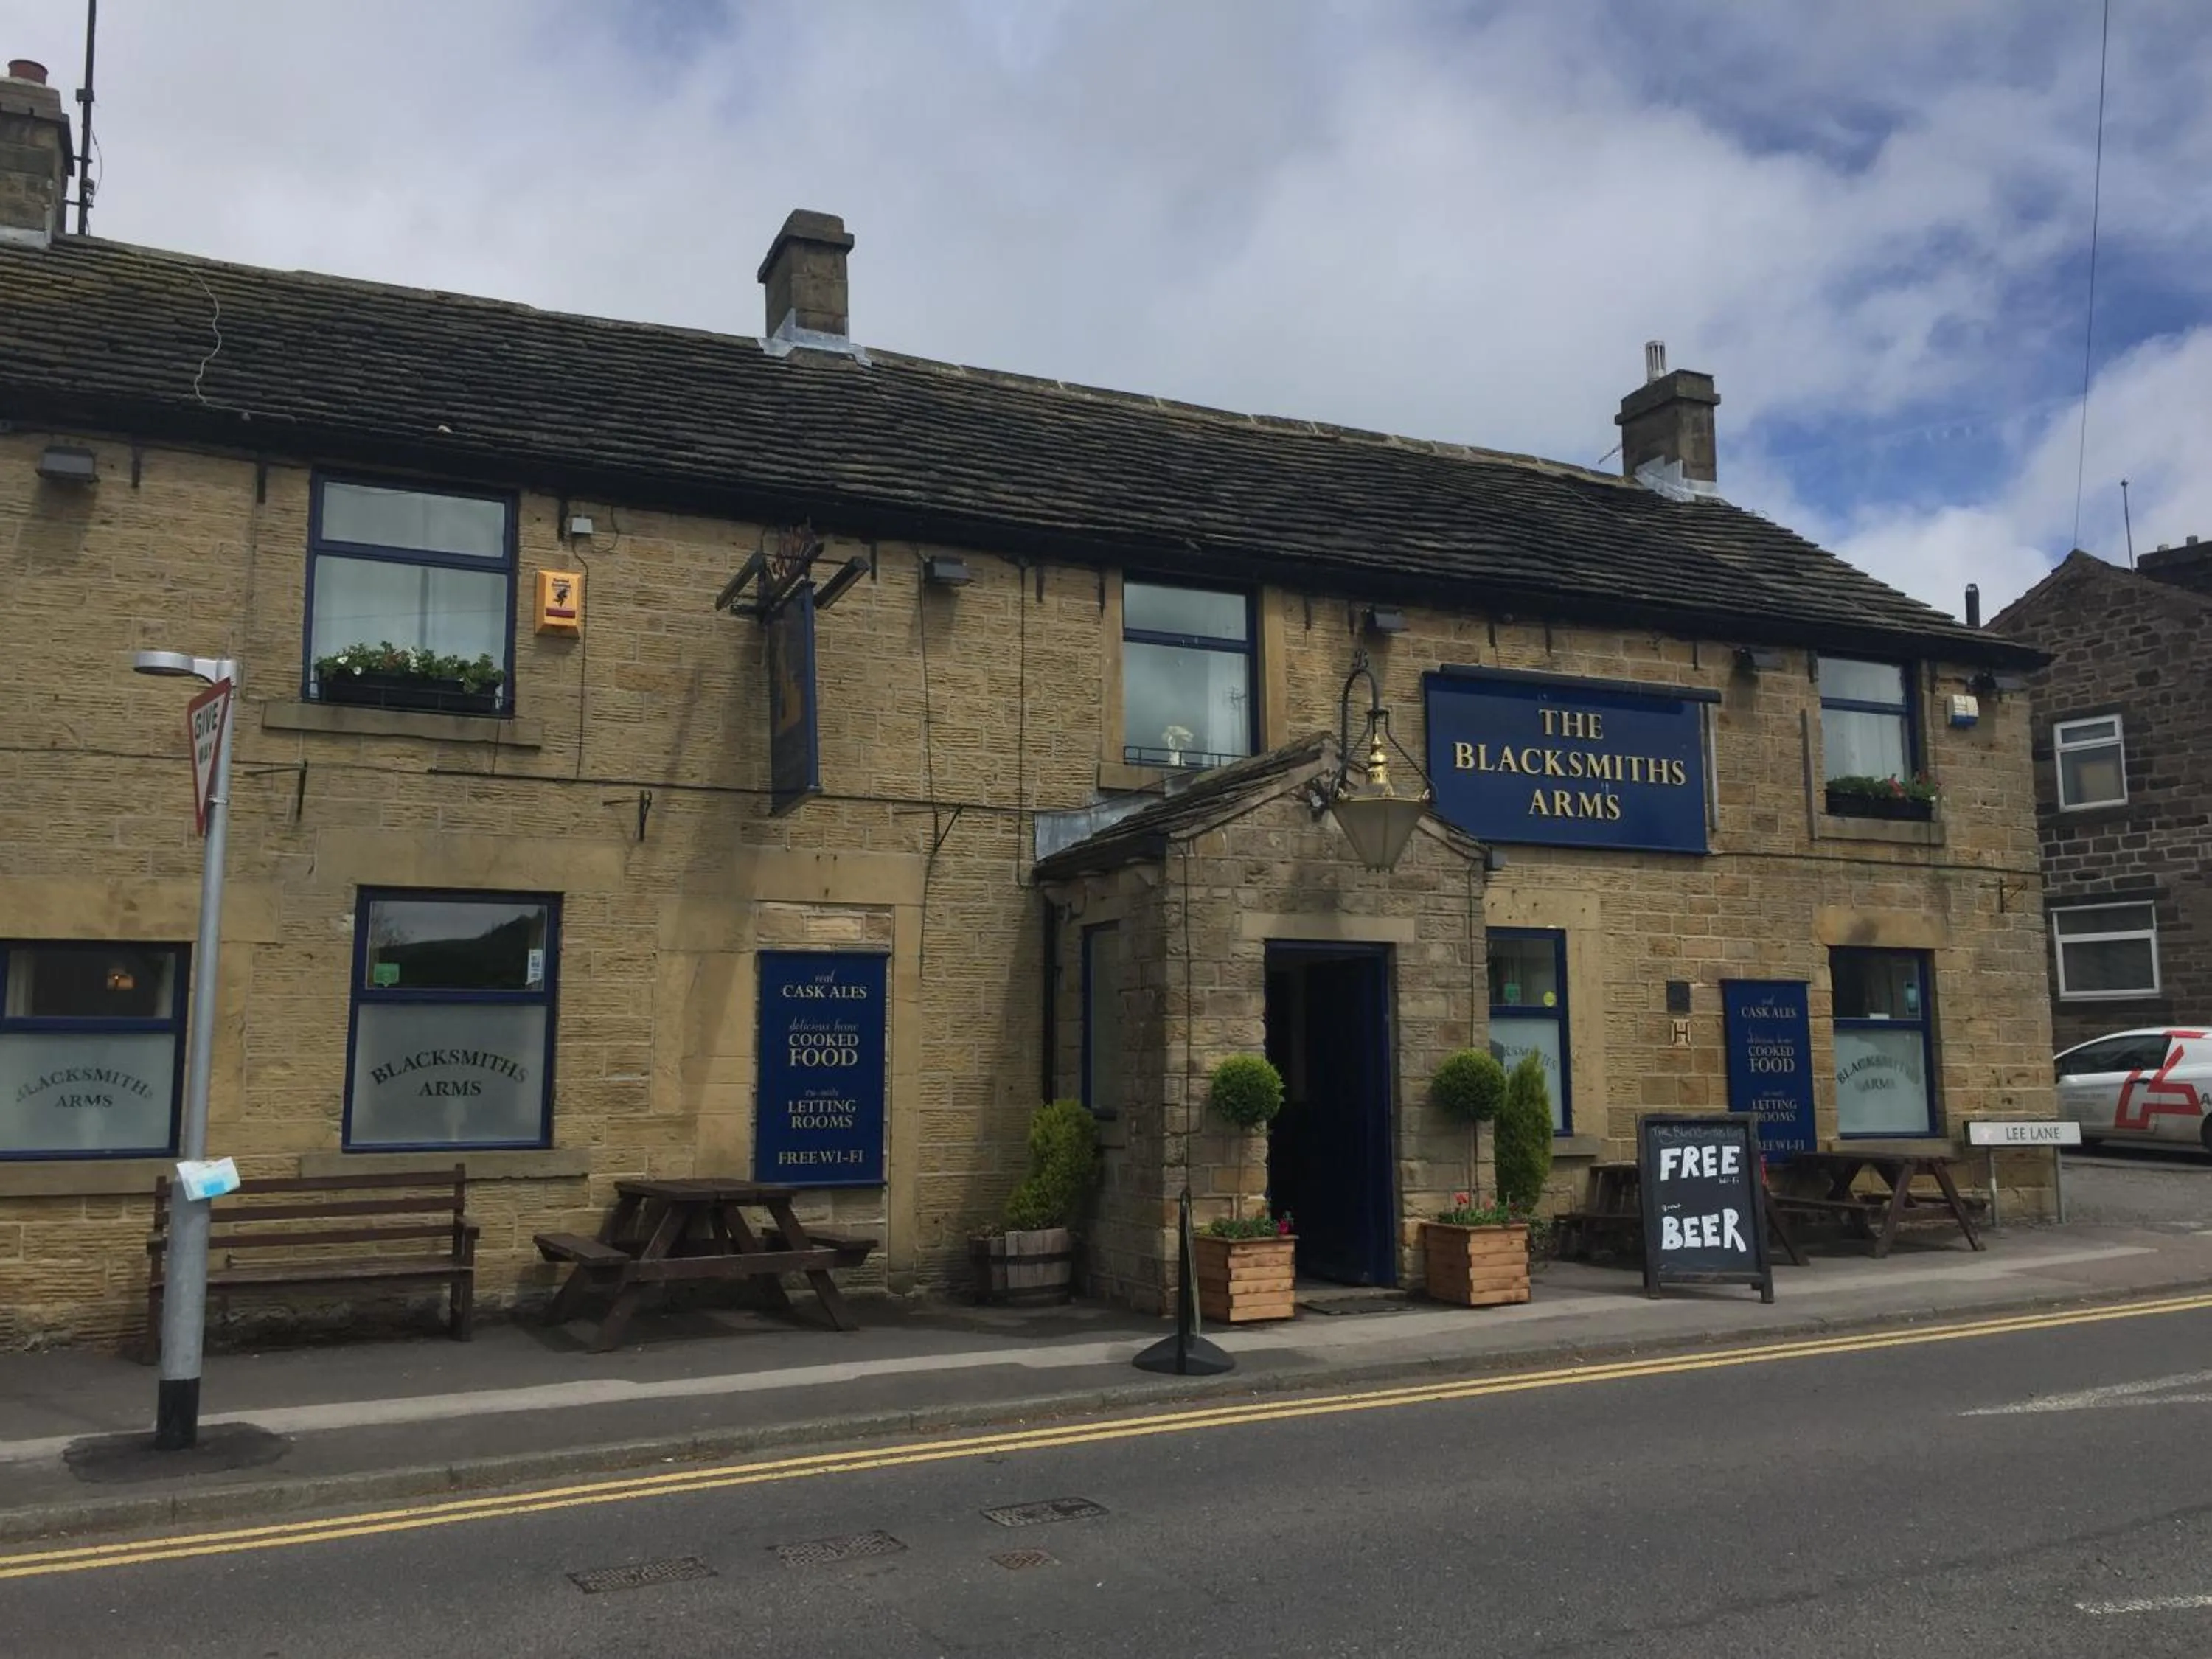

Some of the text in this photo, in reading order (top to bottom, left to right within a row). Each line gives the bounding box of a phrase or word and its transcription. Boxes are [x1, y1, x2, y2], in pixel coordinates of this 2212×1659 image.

[195, 702, 218, 739] GIVE
[1538, 708, 1604, 740] THE
[198, 741, 214, 765] WAY
[1453, 741, 1686, 785] BLACKSMITHS
[1528, 788, 1621, 821] ARMS
[782, 984, 867, 999] CASK ALES
[1741, 1006, 1797, 1018] CASK ALES
[788, 1033, 859, 1047] COOKED
[790, 1047, 858, 1067] FOOD
[1748, 1046, 1795, 1057] COOKED
[370, 1049, 530, 1085] BLACKSMITHS
[1750, 1057, 1795, 1073] FOOD
[418, 1080, 482, 1097] ARMS
[55, 1094, 114, 1108] ARMS
[787, 1099, 856, 1113] LETTING
[1752, 1099, 1798, 1110] LETTING
[790, 1114, 853, 1129] ROOMS
[2006, 1126, 2061, 1141] LEE LANE
[778, 1150, 864, 1165] FREE WI-FI
[1660, 1145, 1741, 1181] FREE
[1661, 1208, 1747, 1253] BEER
